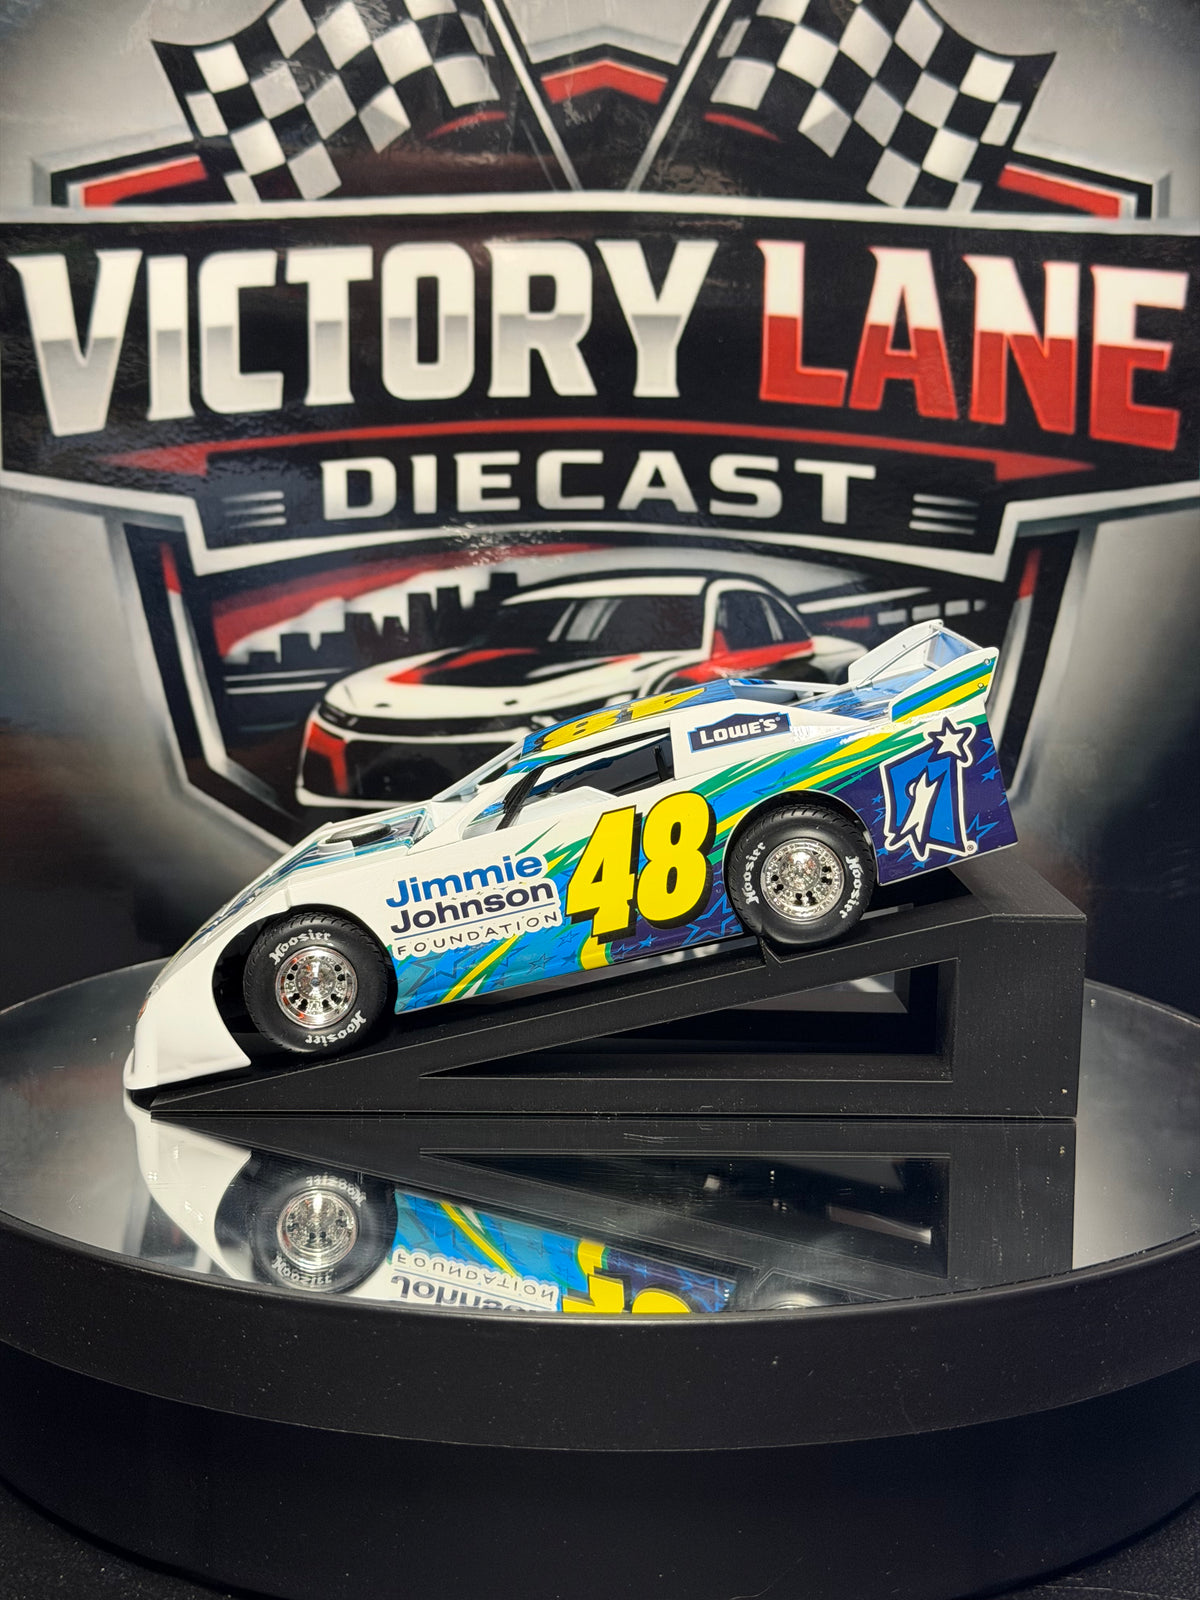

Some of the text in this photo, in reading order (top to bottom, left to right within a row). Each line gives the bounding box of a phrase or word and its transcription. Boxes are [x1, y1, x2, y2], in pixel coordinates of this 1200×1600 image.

[7, 239, 1189, 451] VICTORY LANE
[320, 449, 876, 525] DIECAST
[386, 855, 543, 908] Jimmie
[565, 790, 714, 942] 48
[741, 842, 766, 905] Hoosier
[839, 855, 864, 919] Hoosier
[391, 883, 554, 934] Johnson
[398, 911, 558, 955] FOUNDATION
[269, 929, 332, 965] Hoosier
[305, 1010, 367, 1047] Hoosier
